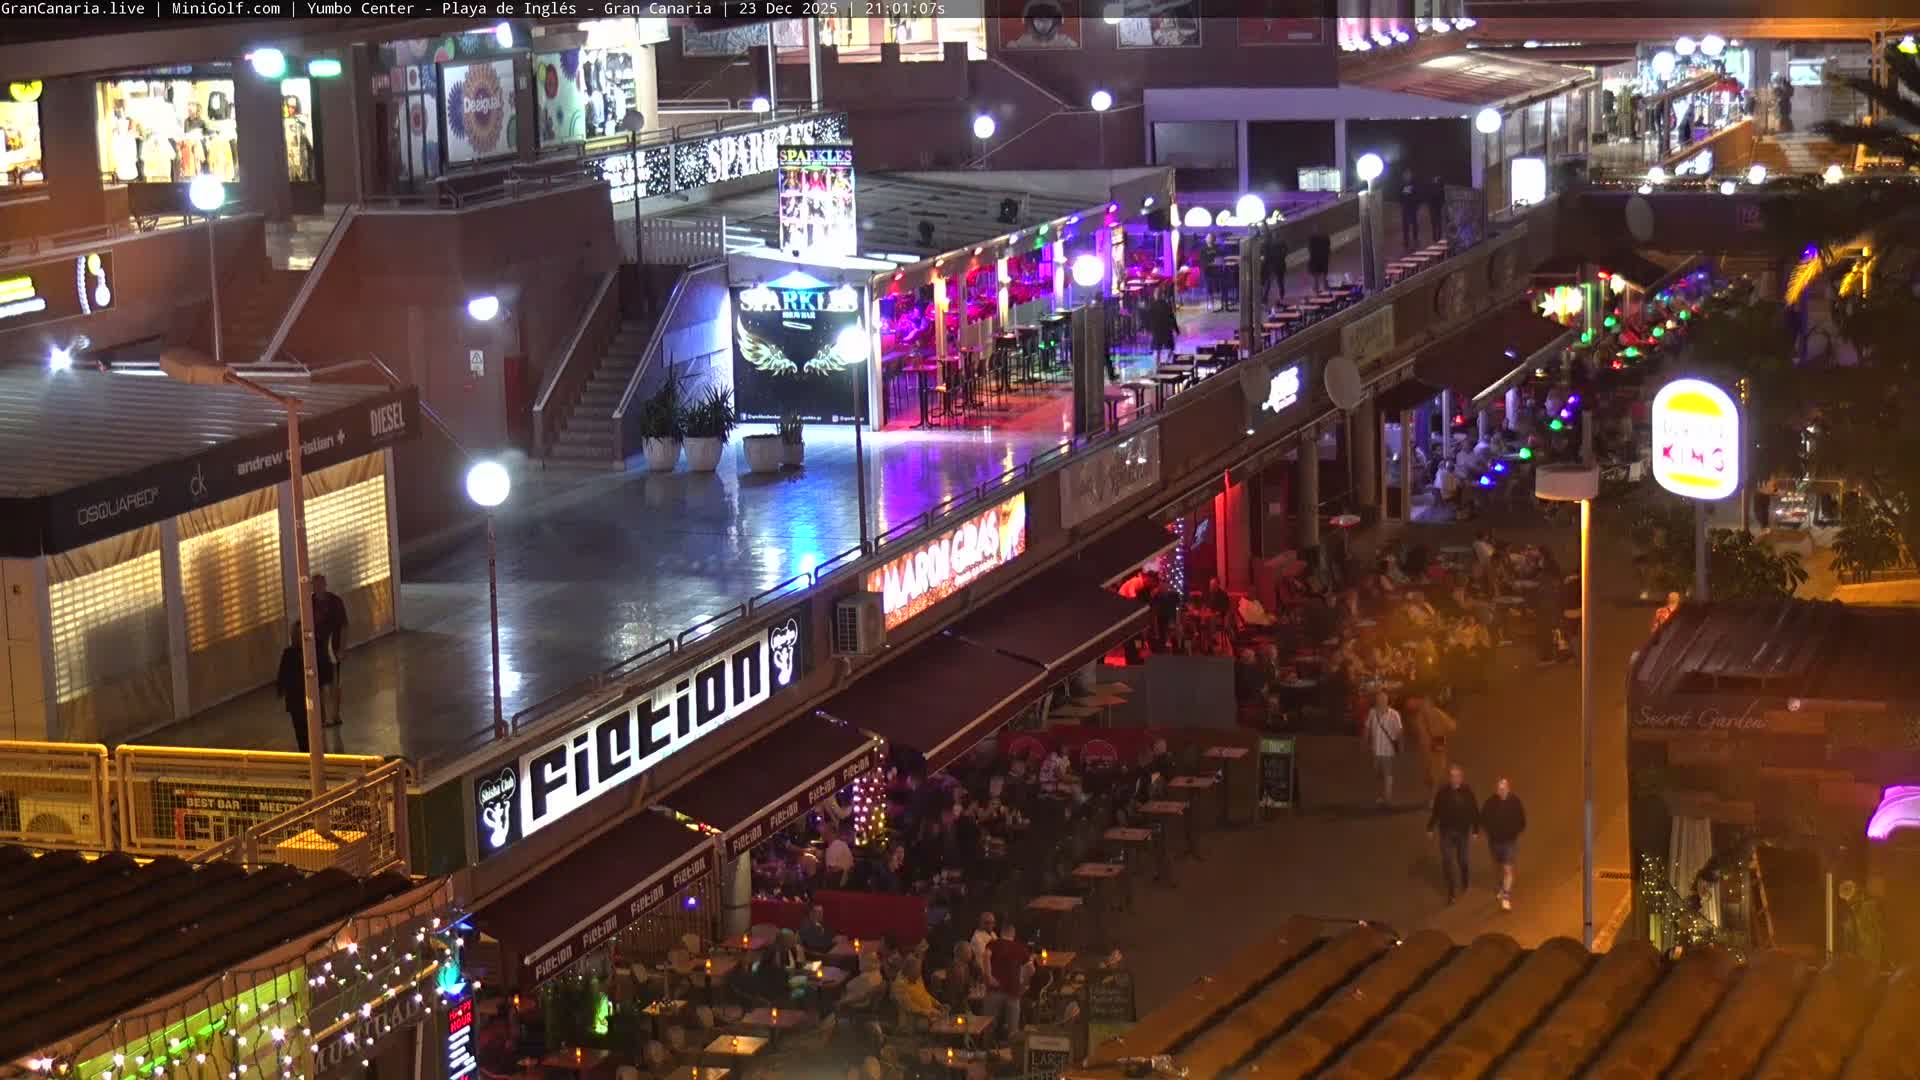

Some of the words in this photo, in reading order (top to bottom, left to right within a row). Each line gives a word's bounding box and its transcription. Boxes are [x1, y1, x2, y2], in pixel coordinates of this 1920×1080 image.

[463, 95, 503, 114] Desigual
[780, 148, 853, 162] SPARKLES
[370, 401, 406, 436] DIESEL
[237, 451, 283, 475] andrew
[186, 797, 214, 808] BEST
[450, 1011, 472, 1033] HOUR
